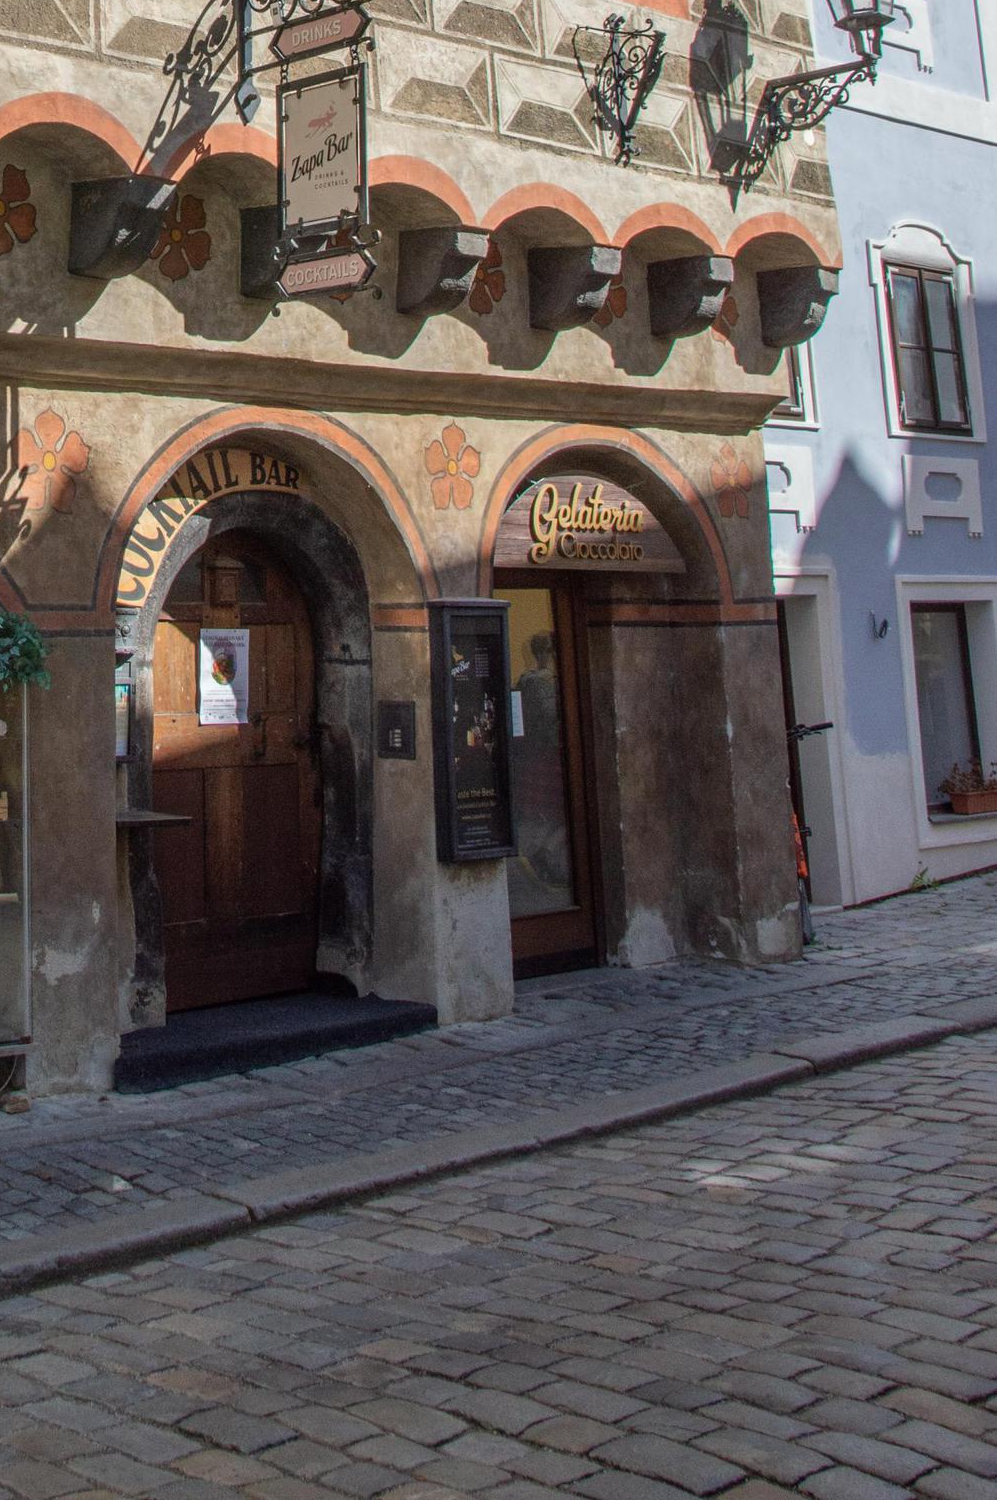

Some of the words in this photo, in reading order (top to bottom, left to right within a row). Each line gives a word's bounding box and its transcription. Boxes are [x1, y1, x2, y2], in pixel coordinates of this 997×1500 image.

[292, 20, 341, 46] DRINKS
[291, 150, 324, 182] Zapa
[324, 132, 353, 162] Bar
[315, 172, 338, 180] DRINKS
[315, 179, 349, 190] COCKTAILS
[287, 260, 360, 287] COCKTAILS
[250, 452, 300, 490] BAR
[528, 482, 646, 565] Gelateria
[555, 530, 646, 561] Cioccolato
